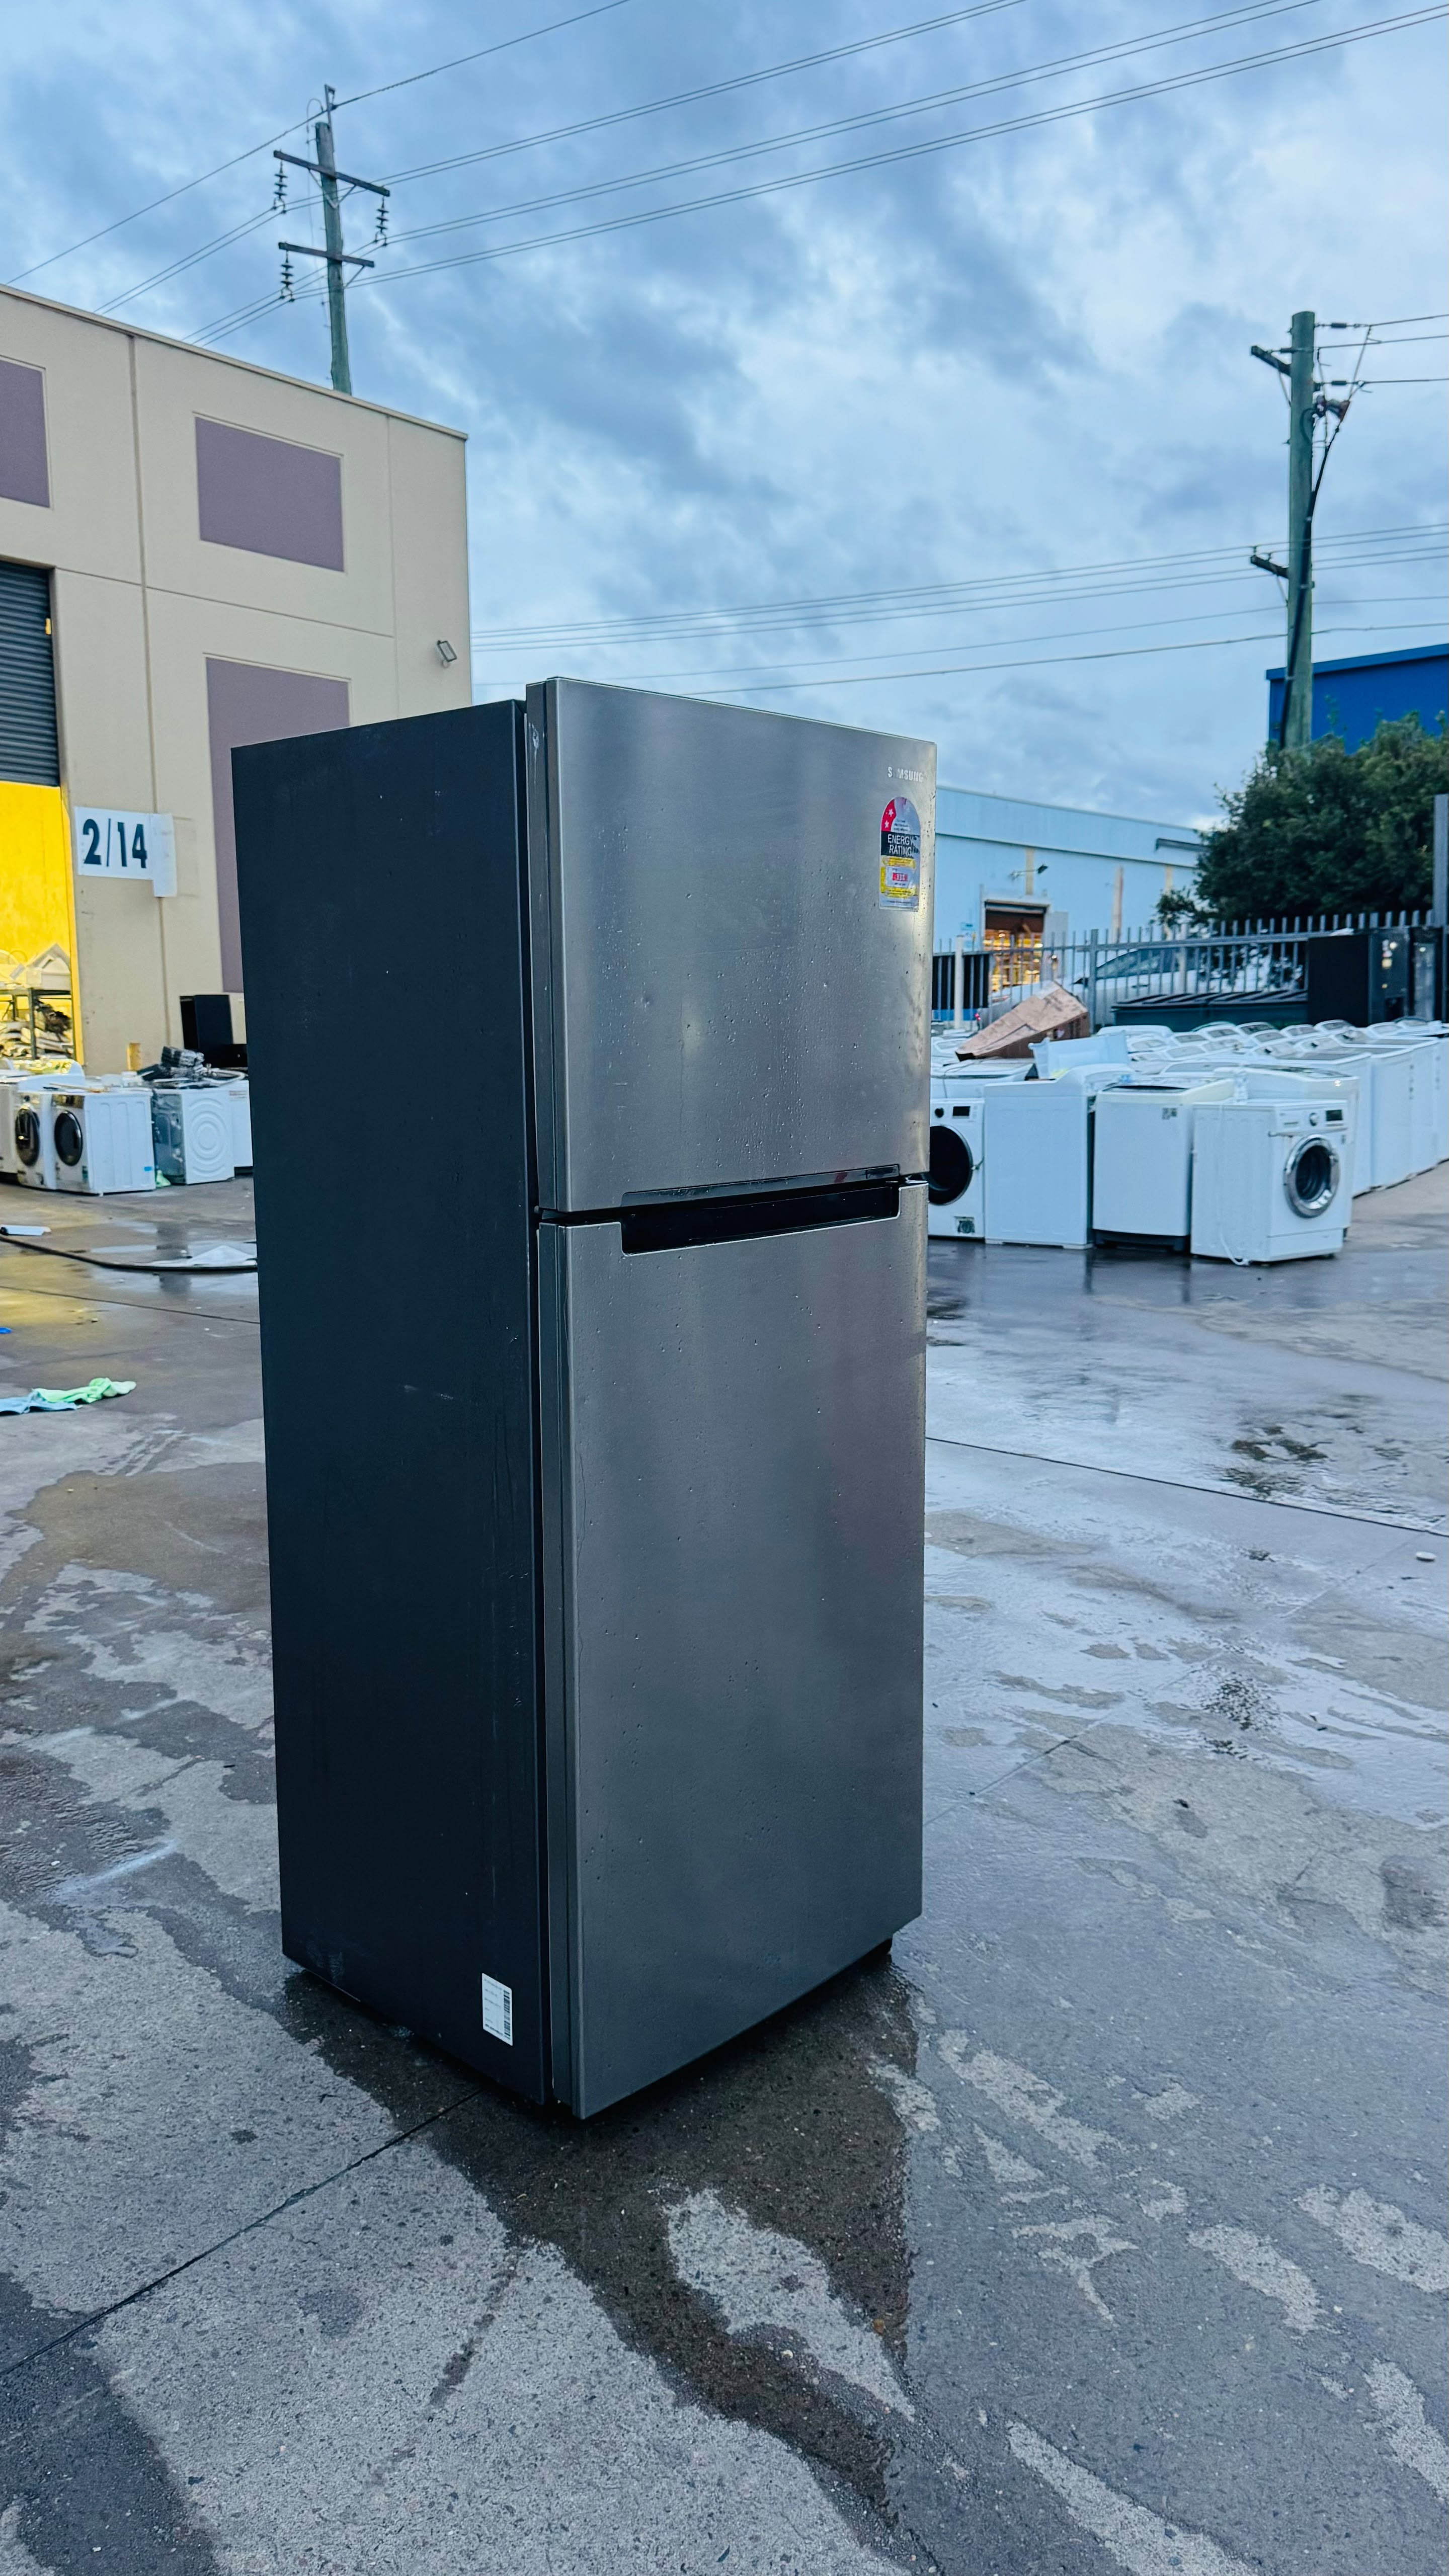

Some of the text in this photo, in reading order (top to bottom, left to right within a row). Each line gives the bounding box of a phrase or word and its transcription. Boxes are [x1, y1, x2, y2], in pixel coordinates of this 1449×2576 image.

[888, 766, 924, 782] SMSUNG
[83, 818, 147, 869] 2/14
[888, 834, 914, 845] ENERGY
[889, 844, 912, 856] RATING
